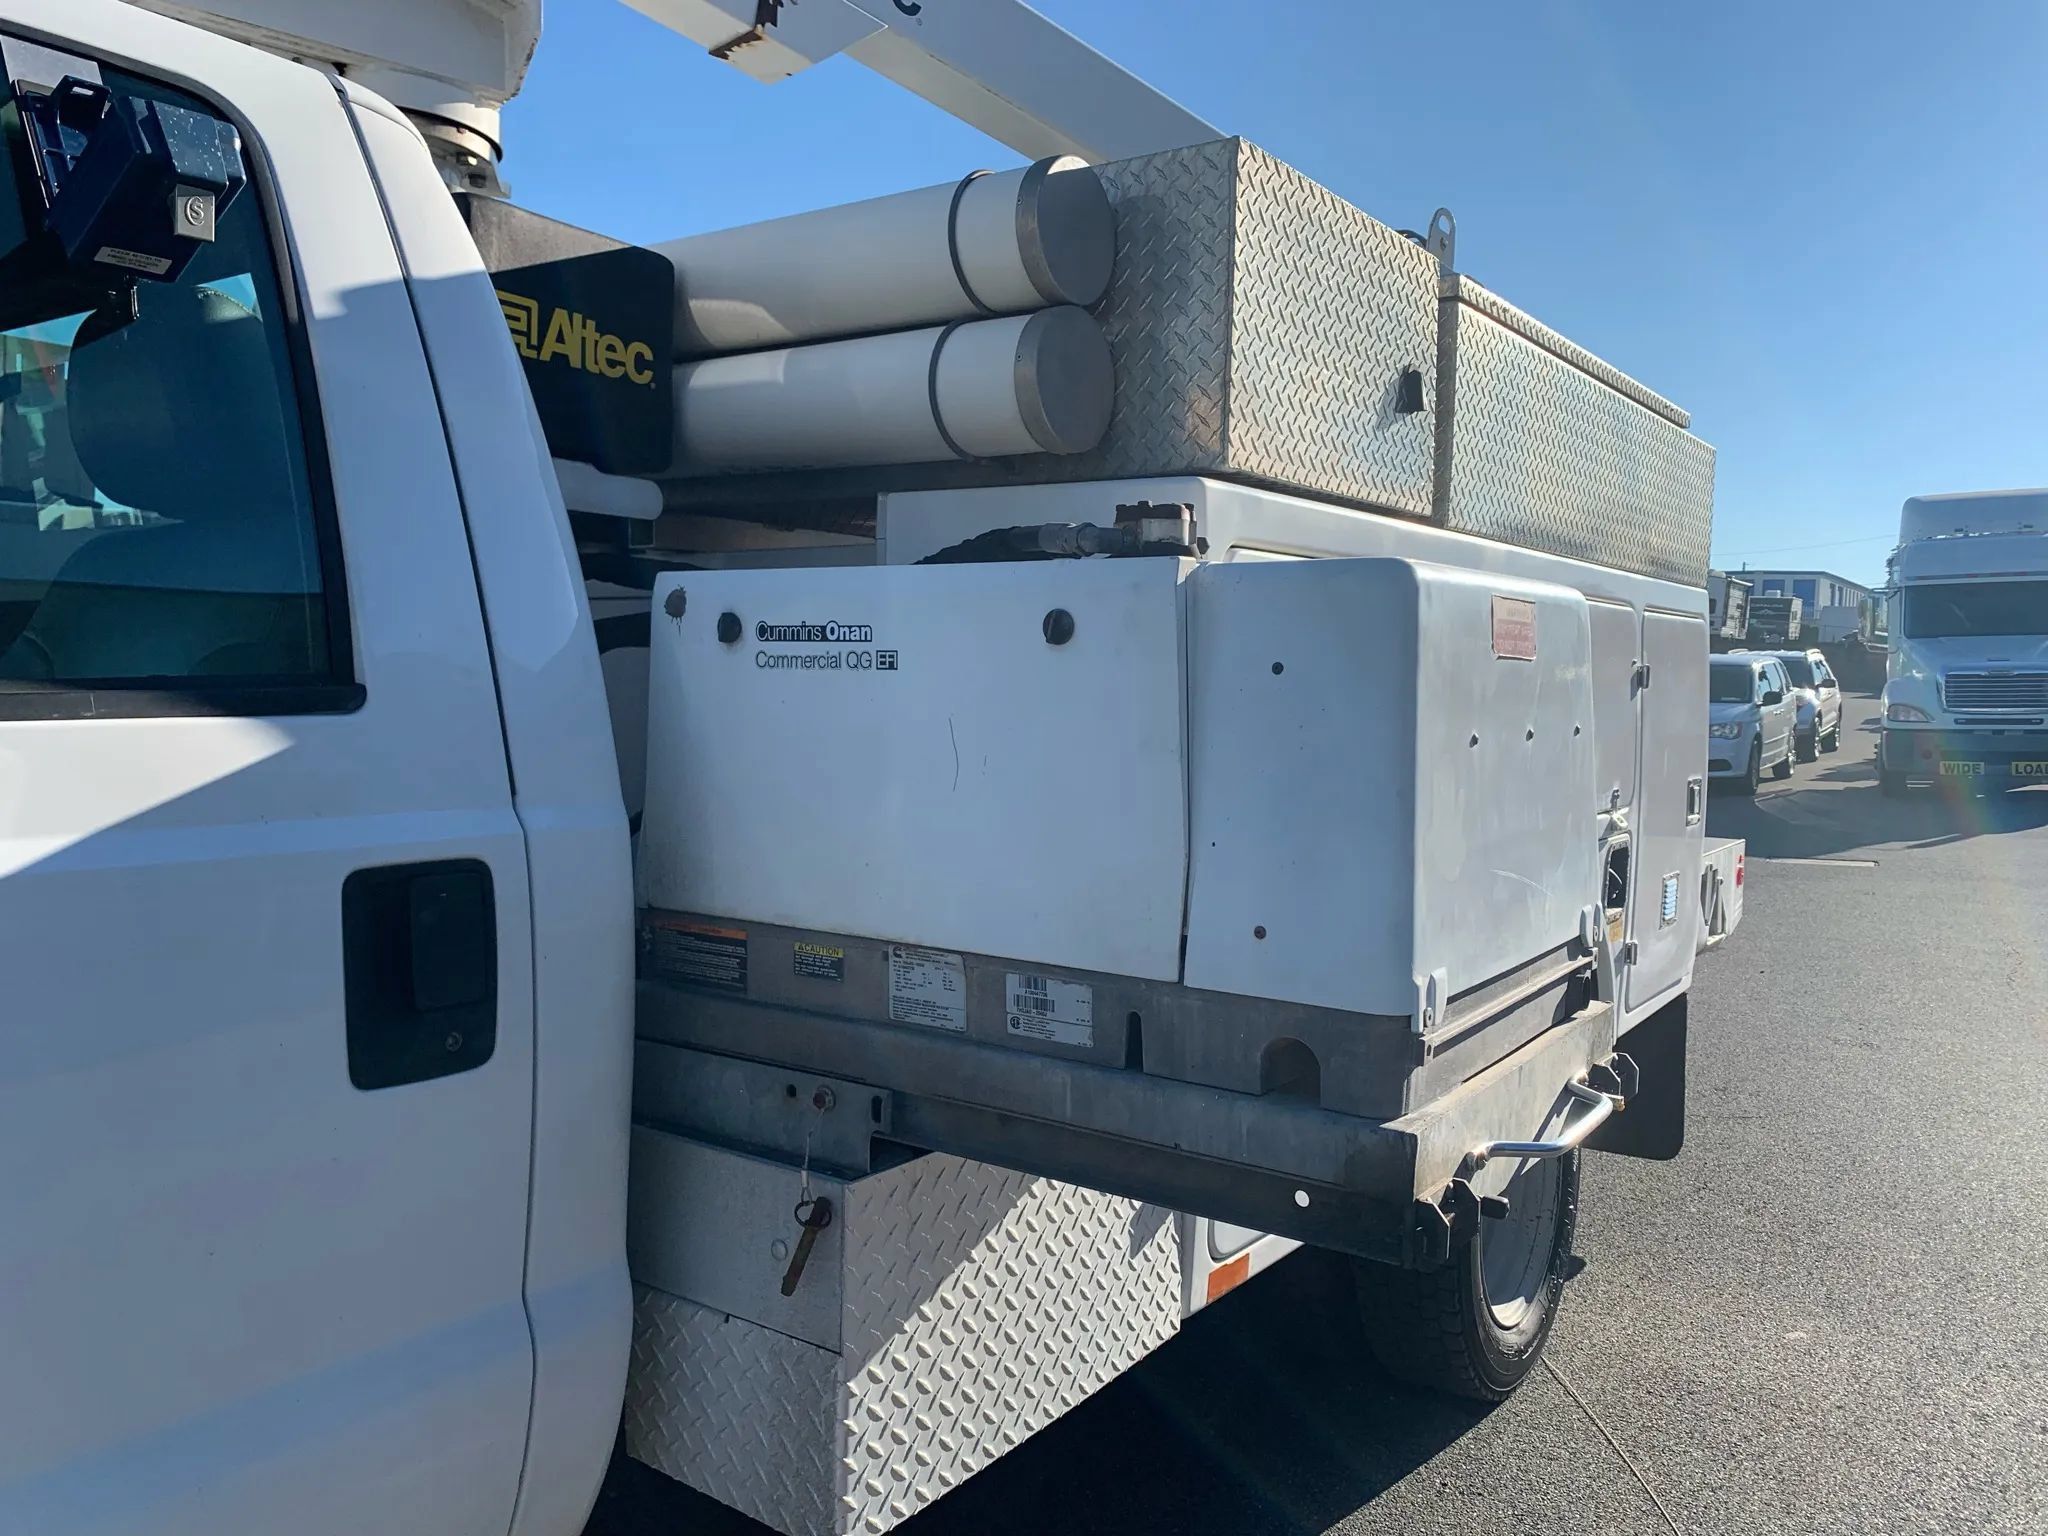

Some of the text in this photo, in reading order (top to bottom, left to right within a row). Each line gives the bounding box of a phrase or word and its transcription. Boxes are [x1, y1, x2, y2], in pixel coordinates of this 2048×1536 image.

[539, 307, 654, 385] Altec
[756, 620, 873, 642] Cummins Onan
[756, 650, 841, 669] Commercial
[846, 651, 872, 669] QG
[1942, 762, 2048, 775] WIDE LOA
[804, 943, 840, 956] CAUTION
